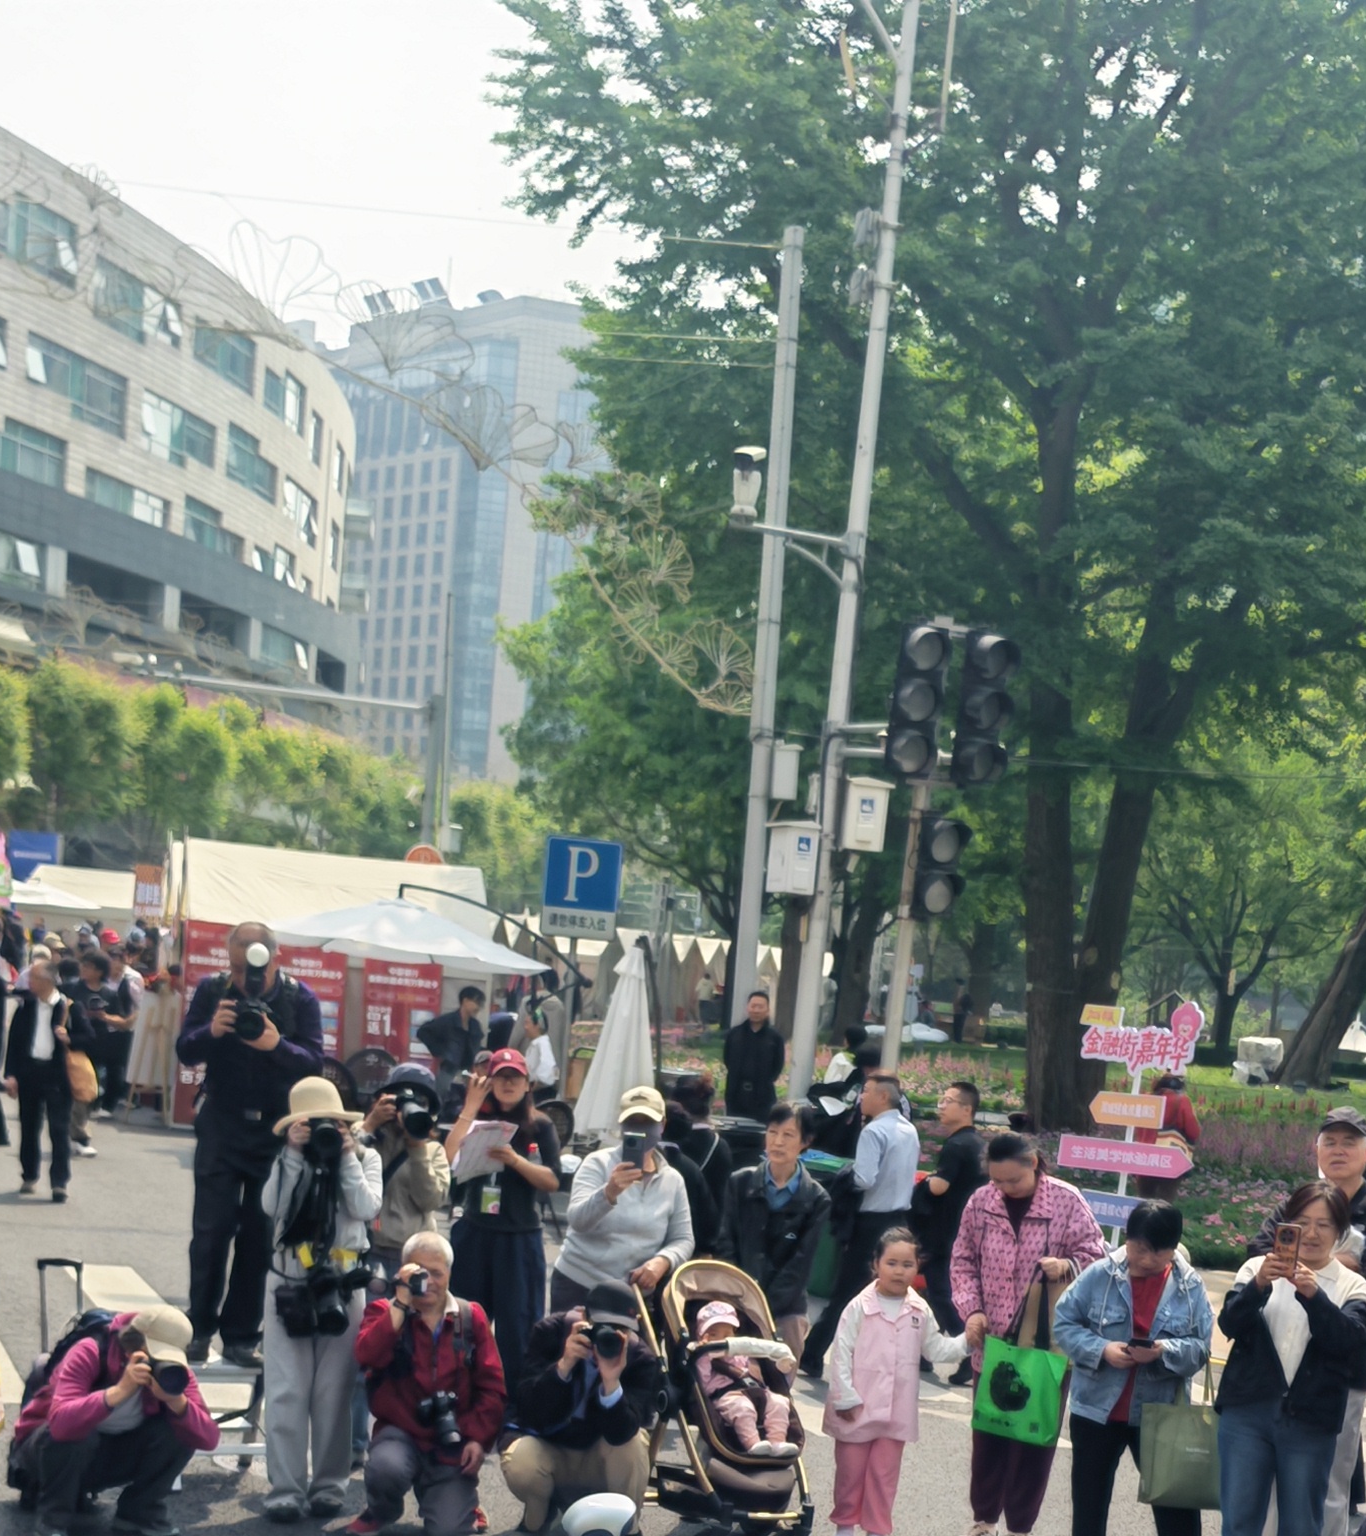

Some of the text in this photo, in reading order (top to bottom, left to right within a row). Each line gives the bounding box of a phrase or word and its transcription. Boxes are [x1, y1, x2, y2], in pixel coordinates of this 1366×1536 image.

[563, 845, 600, 902] P
[1084, 1026, 1190, 1072] 金融街嘉年华
